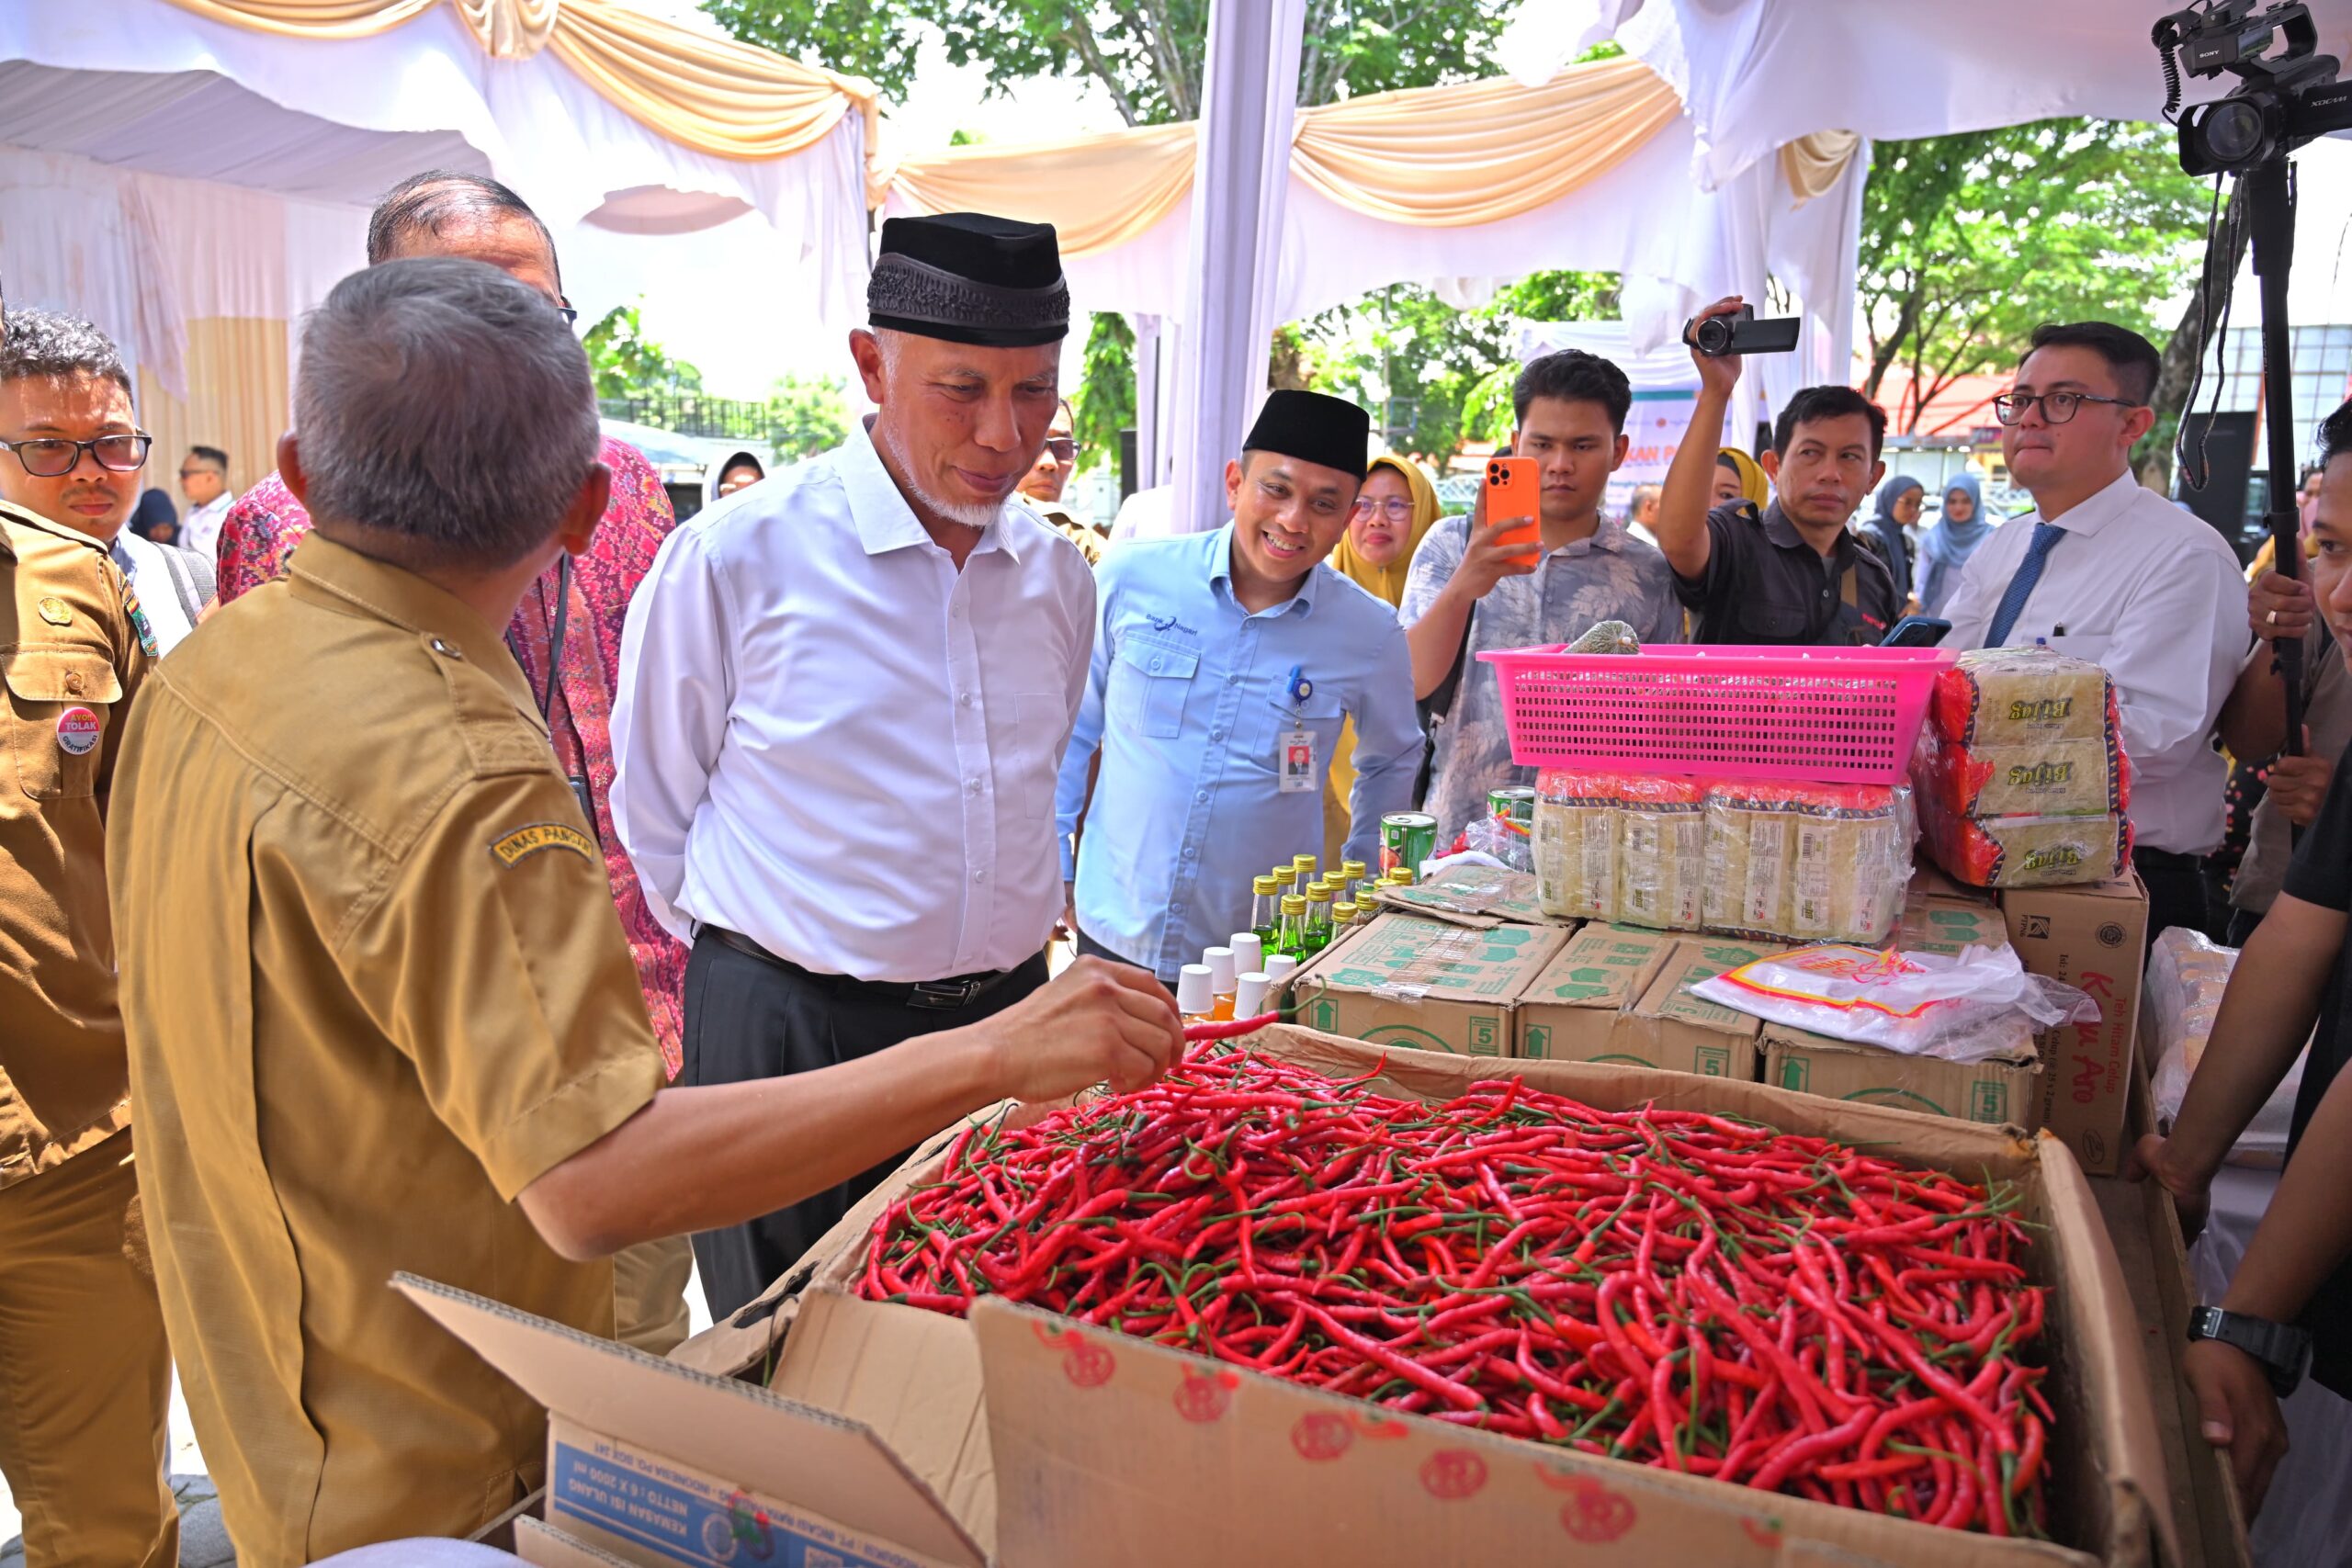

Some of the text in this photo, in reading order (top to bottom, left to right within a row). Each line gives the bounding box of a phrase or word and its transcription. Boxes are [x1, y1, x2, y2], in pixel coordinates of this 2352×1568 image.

[2199, 50, 2220, 59] SONY
[1146, 614, 1198, 637] Bank Nagari
[2009, 698, 2072, 720] Bijag
[65, 721, 96, 730] TOLAK
[63, 735, 97, 752] GRATIFIKASI
[2008, 761, 2072, 786] Bijag
[500, 830, 539, 858] DINAS
[1478, 1028, 1493, 1043] 5
[2106, 998, 2127, 1094] Teh Hitam Celup
[1705, 1058, 1720, 1076] 5
[2072, 1055, 2106, 1104] Aro
[1984, 1094, 1998, 1112] 5
[573, 1460, 588, 1474] ml
[589, 1467, 617, 1489] 2000
[619, 1479, 629, 1493] X
[630, 1483, 639, 1496] 6
[655, 1464, 711, 1496] INDONESIA
[568, 1477, 687, 1536] KEMASAN ISI ULANG
[647, 1490, 688, 1517] NETTO
